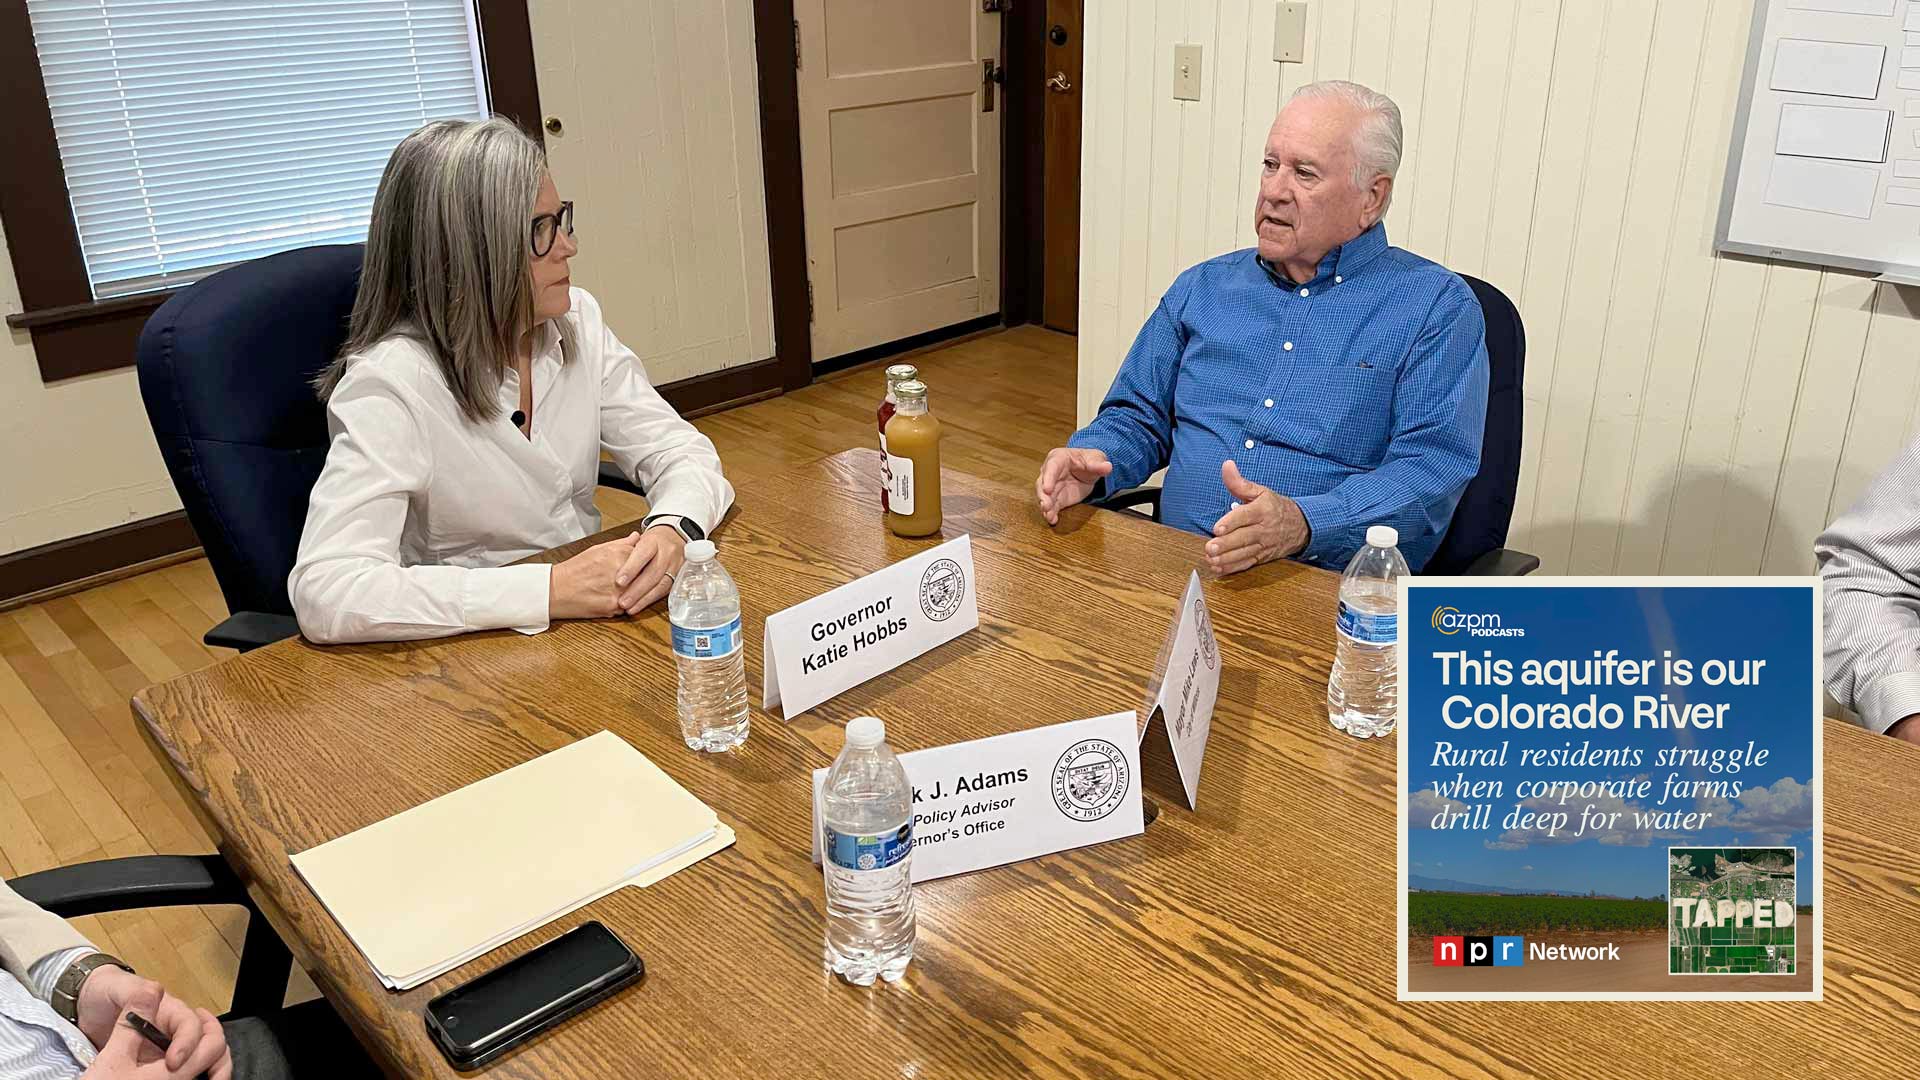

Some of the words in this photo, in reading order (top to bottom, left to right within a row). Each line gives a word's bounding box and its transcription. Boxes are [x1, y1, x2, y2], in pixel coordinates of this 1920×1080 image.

[811, 596, 892, 641] Governor
[802, 644, 848, 675] Katie
[853, 617, 907, 651] Hobbs
[1065, 753, 1073, 763] OF
[1074, 745, 1089, 755] THE
[1091, 744, 1114, 757] STATE
[1113, 755, 1121, 763] OF
[930, 781, 948, 800] J.
[955, 768, 1028, 795] Adams
[913, 810, 957, 827] Policy
[961, 797, 1016, 817] Advisor
[1084, 808, 1102, 817] 1912
[912, 828, 959, 848] ernor's
[964, 820, 1005, 836] Office
